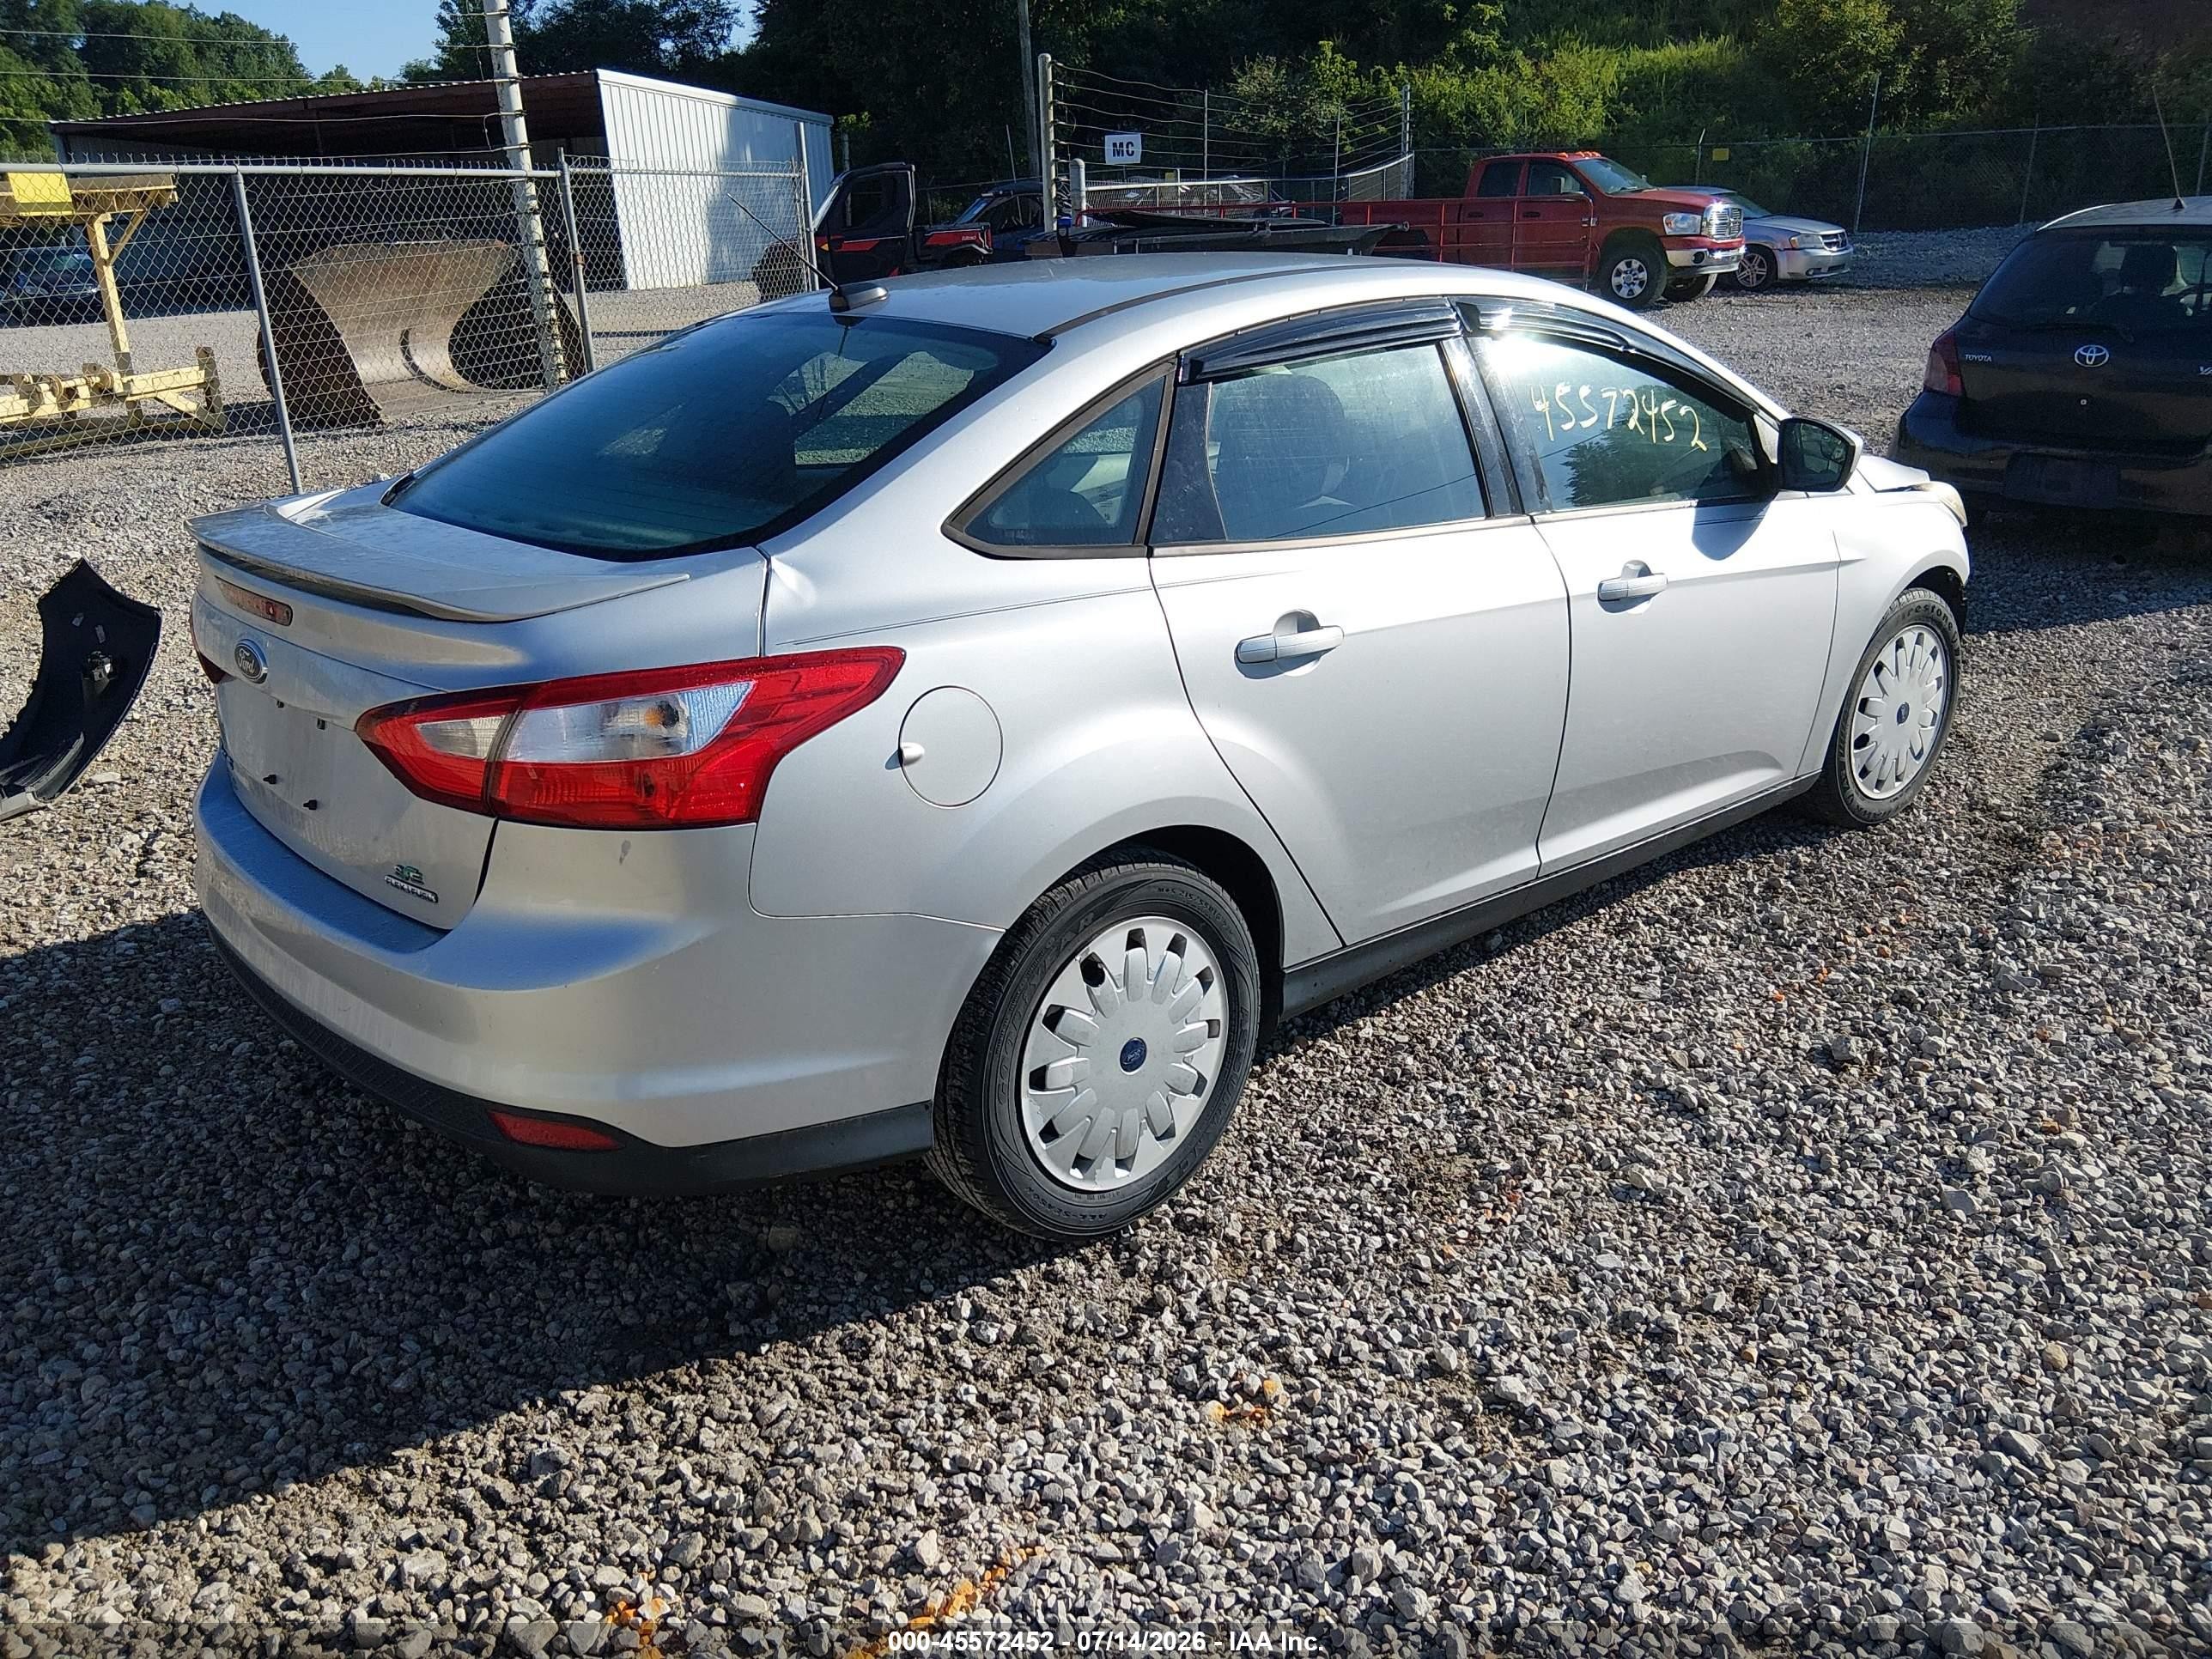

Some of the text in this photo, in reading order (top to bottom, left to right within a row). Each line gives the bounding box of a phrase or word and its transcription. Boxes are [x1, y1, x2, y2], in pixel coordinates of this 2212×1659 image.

[1112, 141, 1134, 158] MC
[1965, 353, 1992, 362] TOYOTA
[1530, 382, 1708, 452] 45572452
[238, 647, 256, 675] Ford
